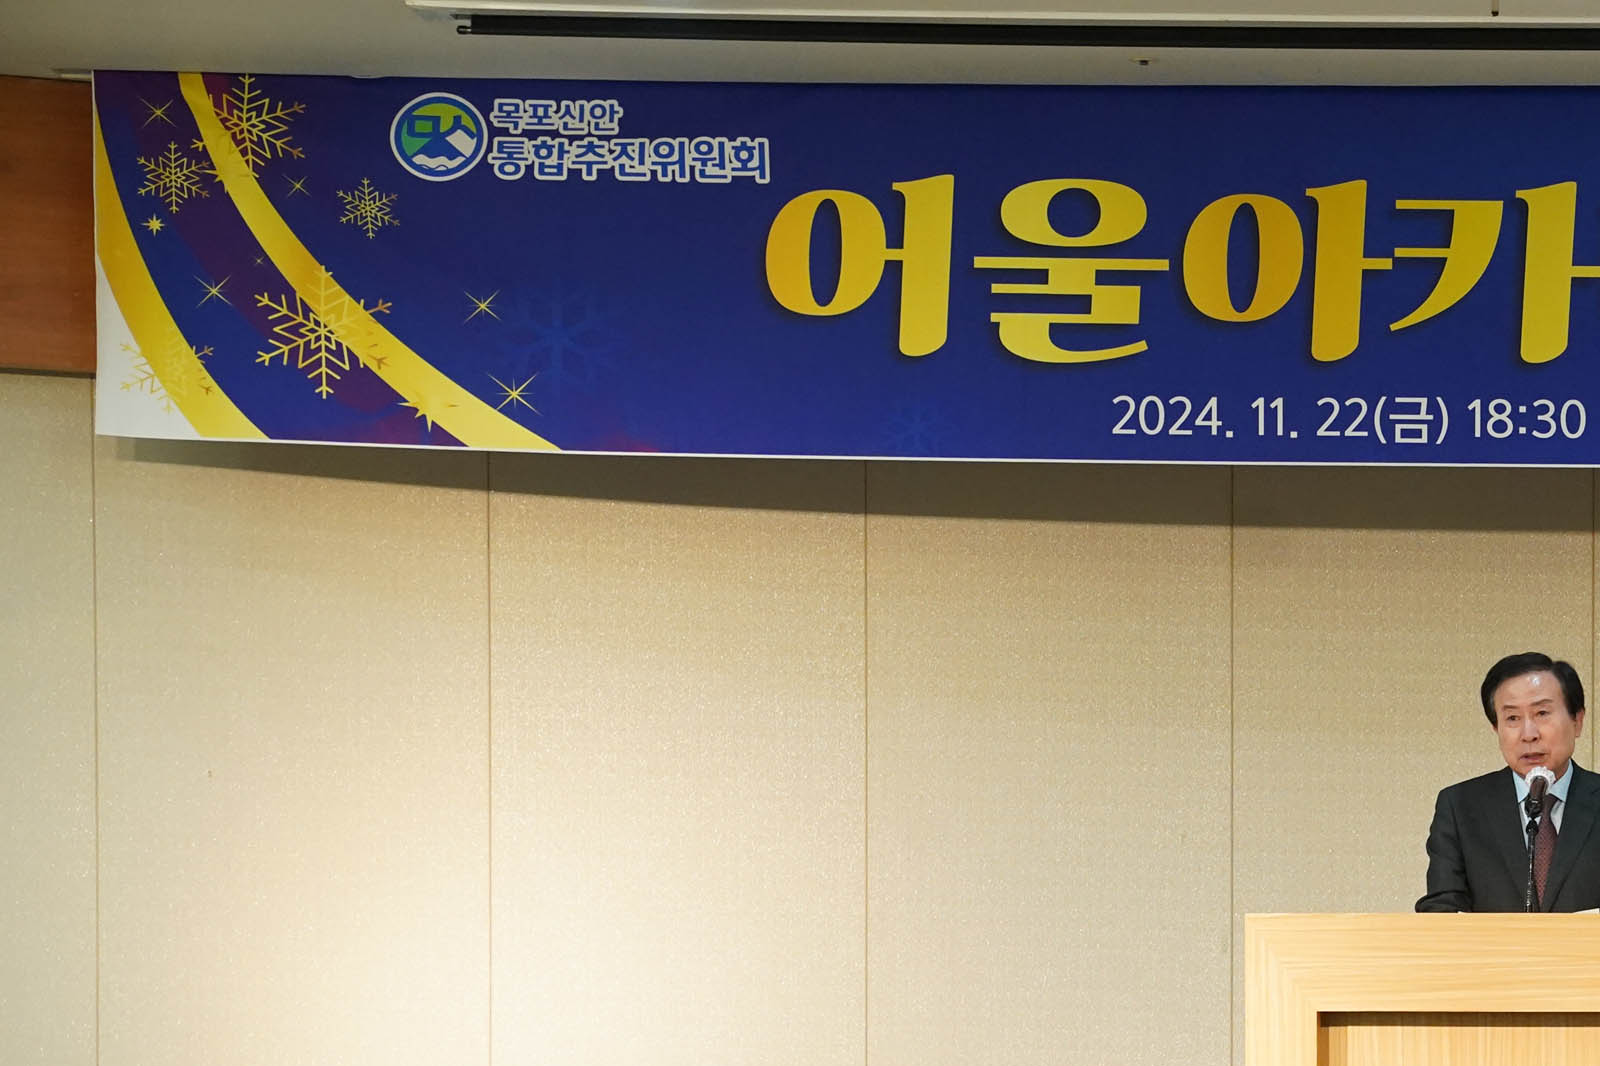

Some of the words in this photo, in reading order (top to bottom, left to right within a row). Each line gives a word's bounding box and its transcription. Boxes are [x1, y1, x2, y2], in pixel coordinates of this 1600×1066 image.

[490, 97, 624, 134] 목포신안
[487, 136, 771, 184] 통합추진위원회
[1113, 396, 1233, 438] 2024.
[1252, 397, 1297, 439] 11.
[1317, 396, 1448, 445] 22(금)
[1468, 398, 1587, 439] 18:30
